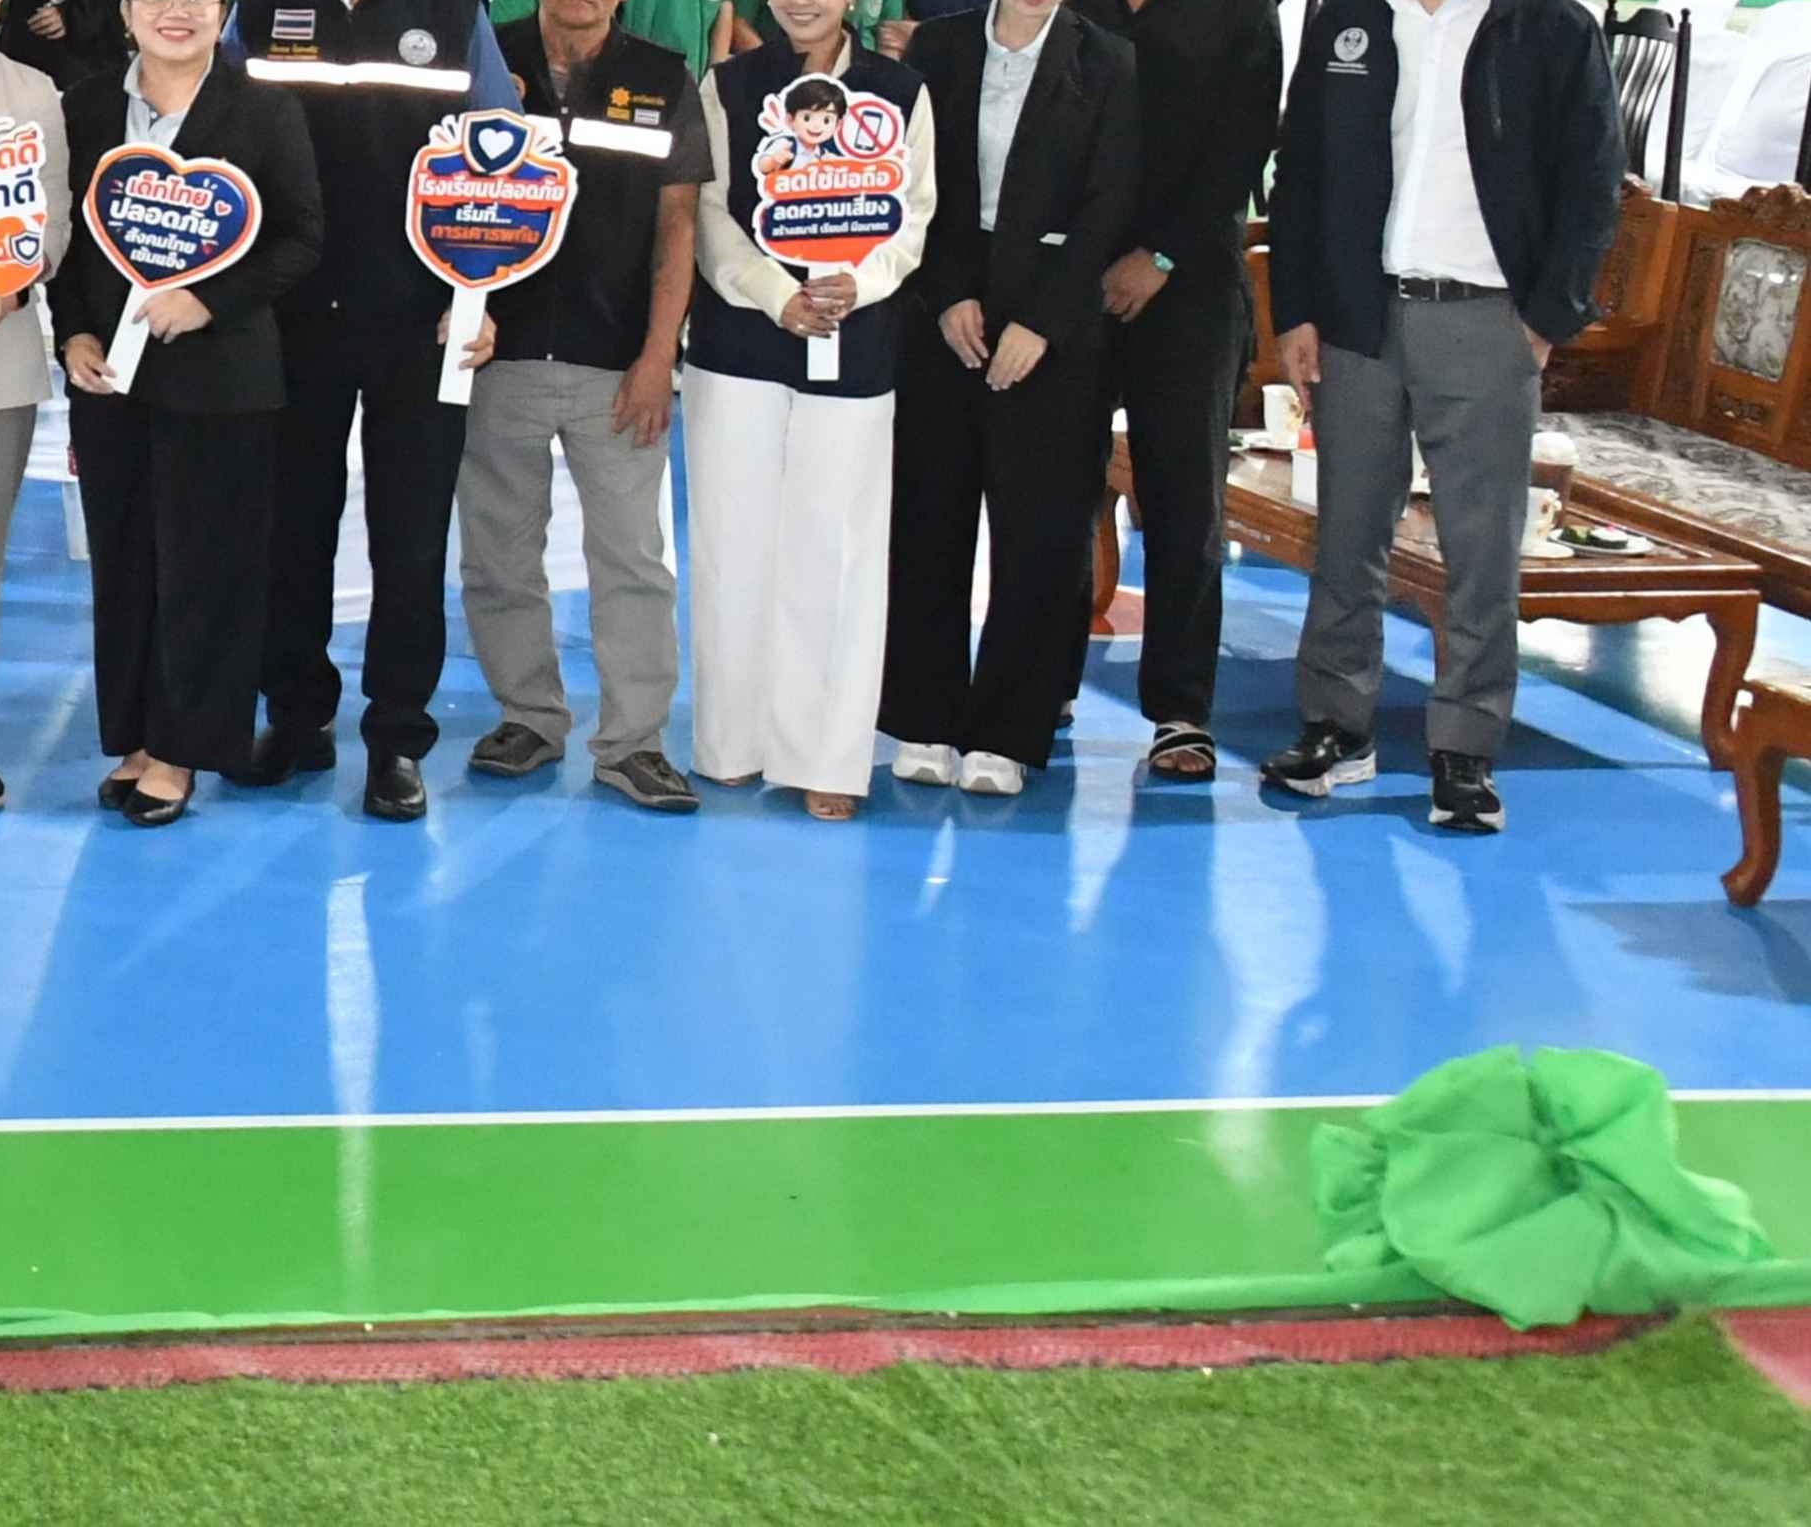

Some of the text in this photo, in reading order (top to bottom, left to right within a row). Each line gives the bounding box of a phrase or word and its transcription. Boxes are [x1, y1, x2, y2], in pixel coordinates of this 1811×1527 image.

[127, 171, 211, 209] เด็กไทย
[417, 173, 566, 201] โรงเรียนปลอดภัย
[774, 165, 891, 193] ลดใช้มือถือ
[110, 198, 220, 238] ปลอดภัย
[773, 191, 891, 221] ลดความเสี่ยง
[123, 227, 198, 255] สังคมไทย
[130, 246, 187, 271] เข้มแข็ง
